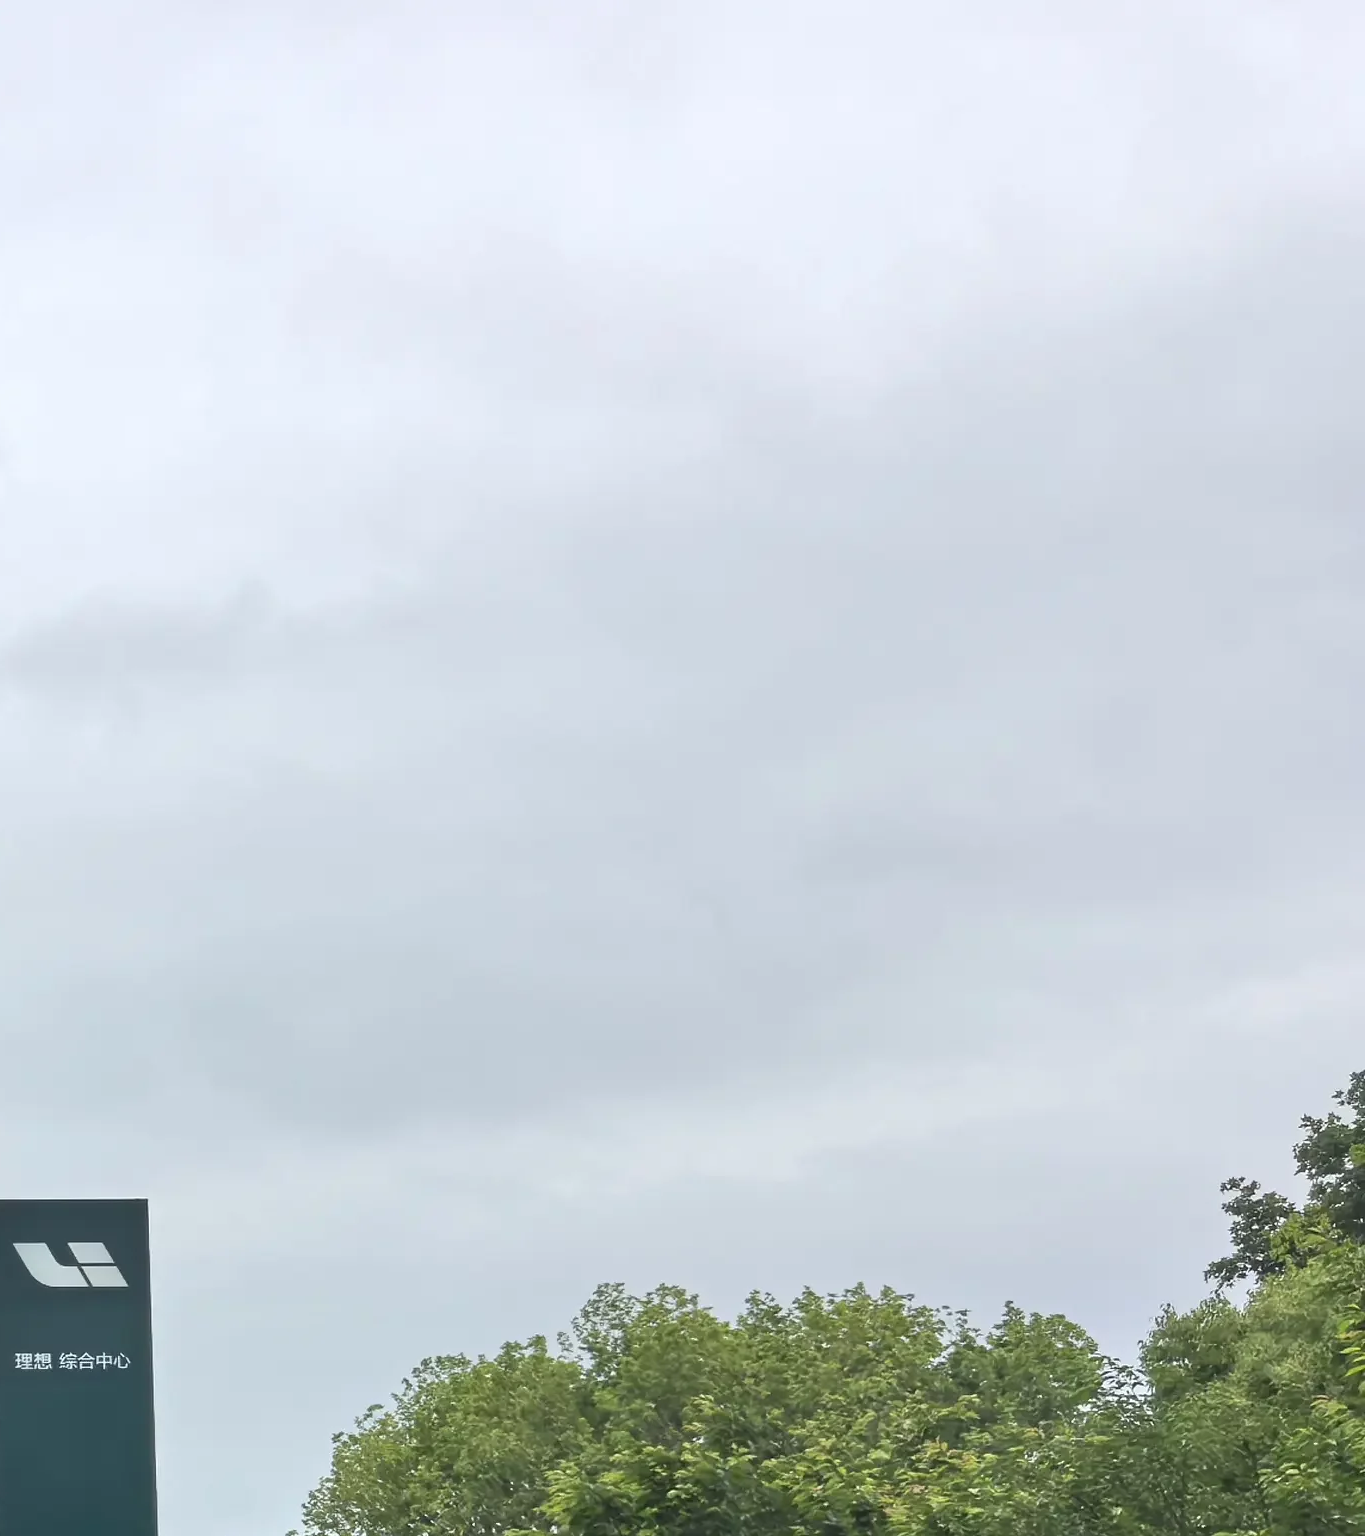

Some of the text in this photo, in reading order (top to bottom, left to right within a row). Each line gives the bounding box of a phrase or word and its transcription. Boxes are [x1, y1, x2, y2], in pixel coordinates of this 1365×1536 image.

[14, 1352, 131, 1371] 理想 综合中心
